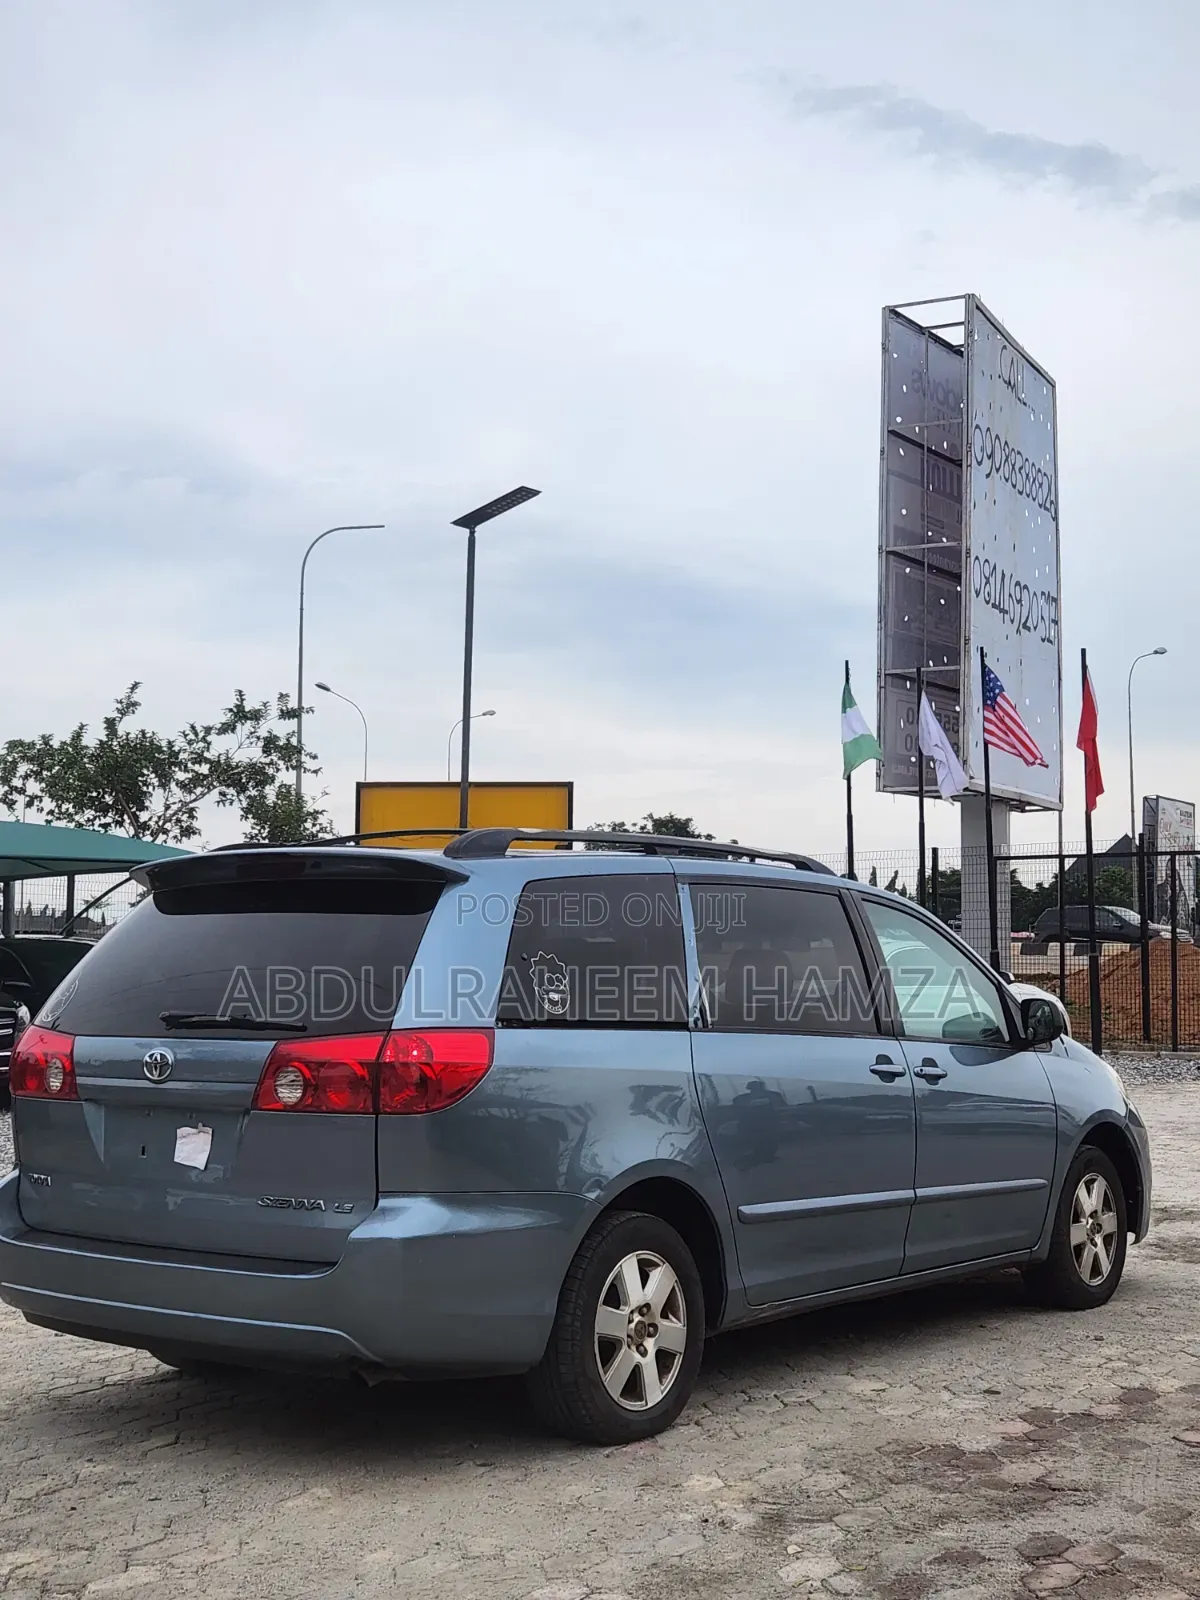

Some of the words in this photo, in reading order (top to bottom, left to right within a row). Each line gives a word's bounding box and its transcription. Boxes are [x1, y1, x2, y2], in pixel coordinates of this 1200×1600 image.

[973, 423, 1057, 522] 09088388826
[972, 555, 1058, 646] 08146920517
[257, 1195, 326, 1212] SIENNA
[333, 1203, 354, 1214] LE
